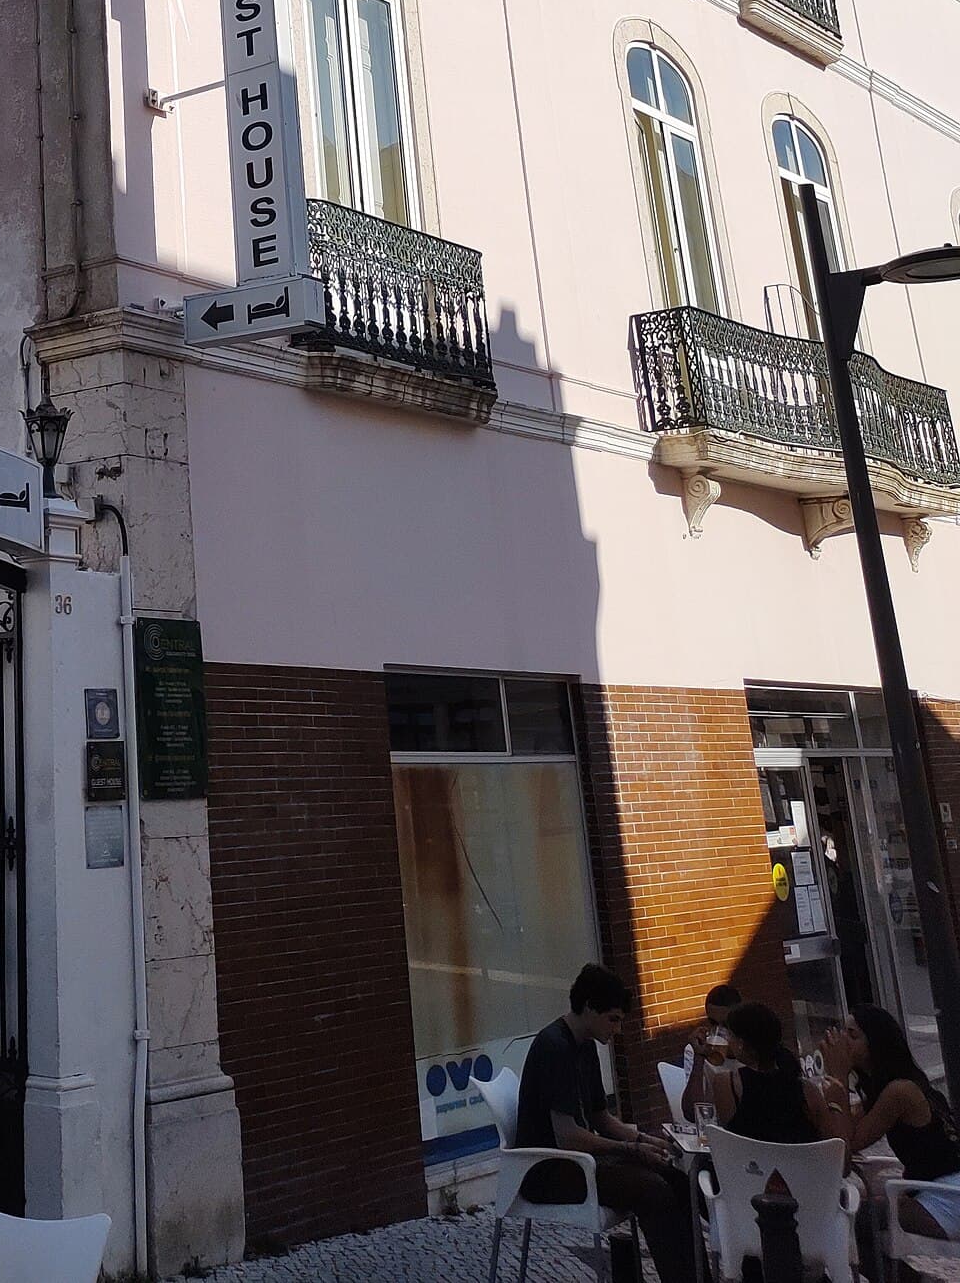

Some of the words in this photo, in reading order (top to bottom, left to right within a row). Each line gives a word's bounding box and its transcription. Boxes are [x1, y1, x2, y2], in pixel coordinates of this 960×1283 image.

[241, 82, 279, 268] HOUSE
[55, 594, 72, 615] 36
[144, 623, 196, 661] CENTRAL
[91, 777, 106, 786] GUEST
[107, 777, 122, 786] HOUSE
